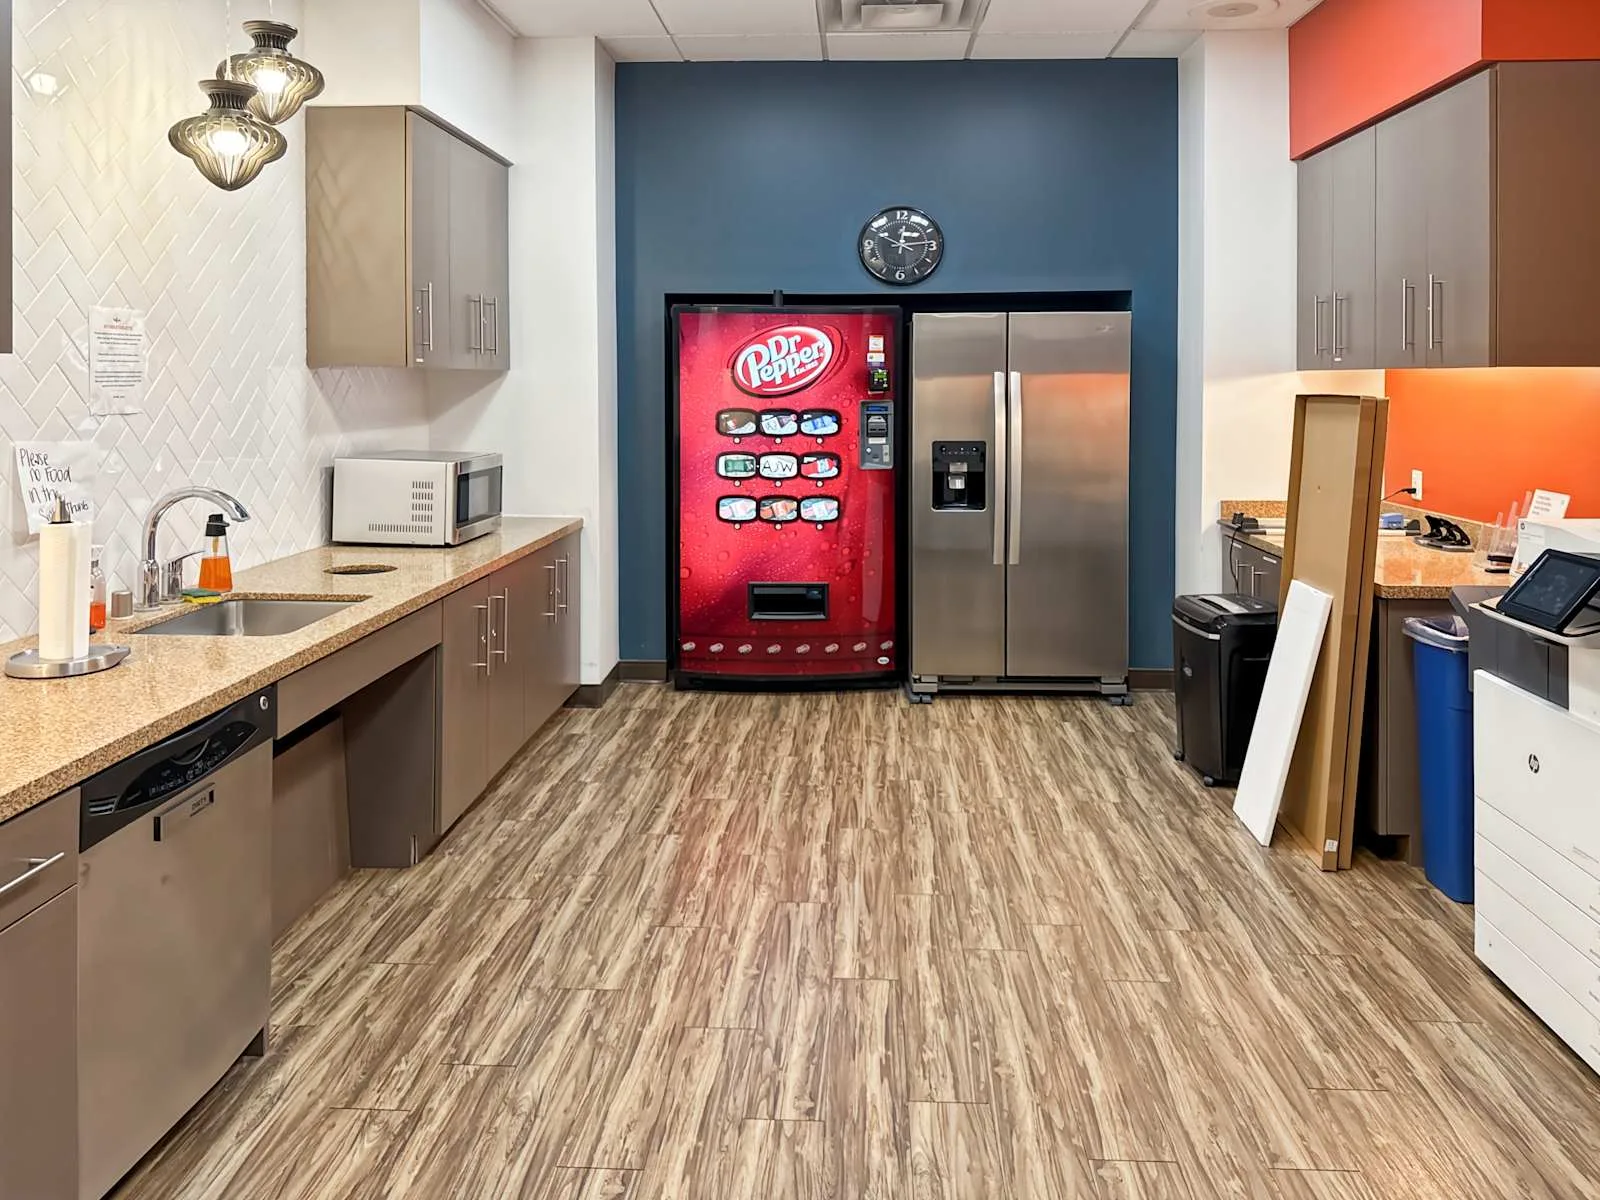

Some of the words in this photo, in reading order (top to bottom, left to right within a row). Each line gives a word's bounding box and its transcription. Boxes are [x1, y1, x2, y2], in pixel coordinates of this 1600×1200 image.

[896, 210, 908, 220] 12
[864, 239, 874, 250] 9
[928, 240, 937, 251] 3
[895, 269, 905, 280] 6
[768, 335, 801, 362] Dr
[745, 341, 824, 389] Pepper
[20, 448, 48, 467] Please
[30, 467, 41, 482] no
[45, 466, 71, 482] Food
[29, 487, 41, 503] in
[42, 485, 59, 502] th
